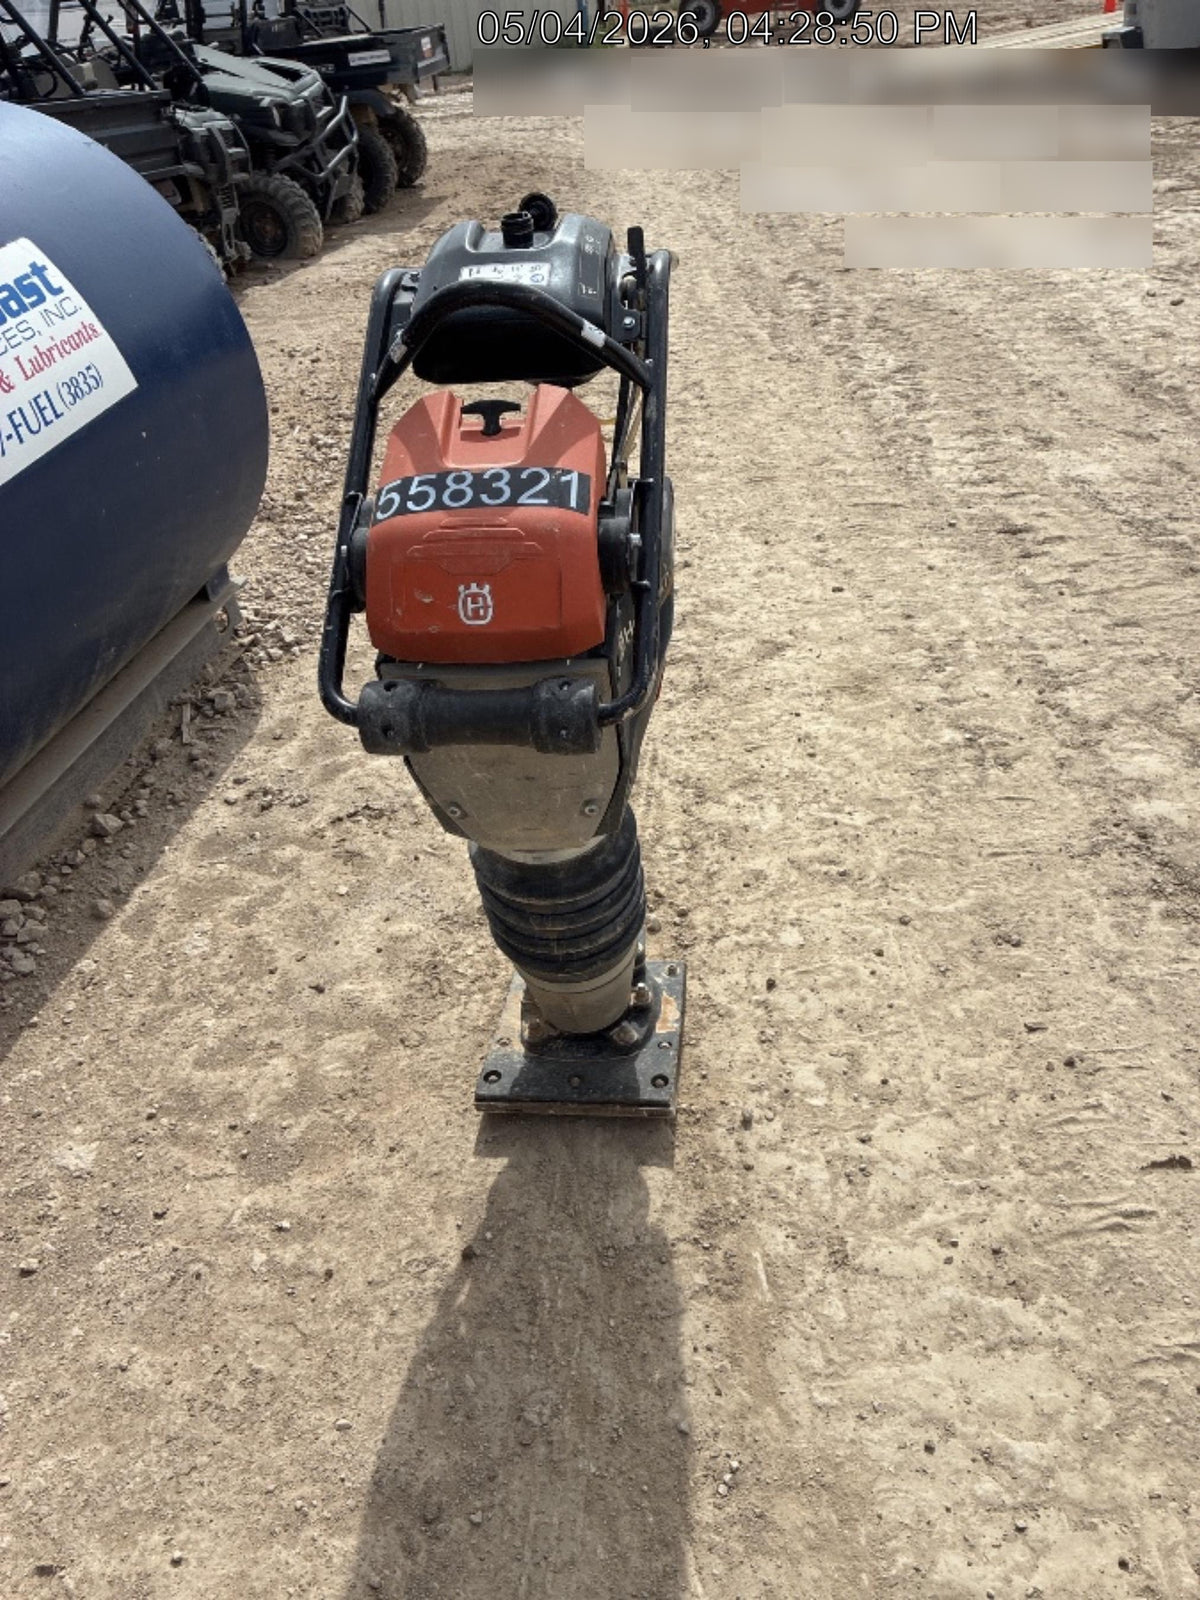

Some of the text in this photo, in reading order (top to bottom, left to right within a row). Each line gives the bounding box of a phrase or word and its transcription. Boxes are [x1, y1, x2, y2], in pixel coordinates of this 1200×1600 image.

[0, 261, 64, 326] ast
[39, 296, 82, 327] INC.
[14, 321, 101, 381] Lubricants
[56, 362, 103, 410] (3835)
[376, 467, 580, 520] 558321
